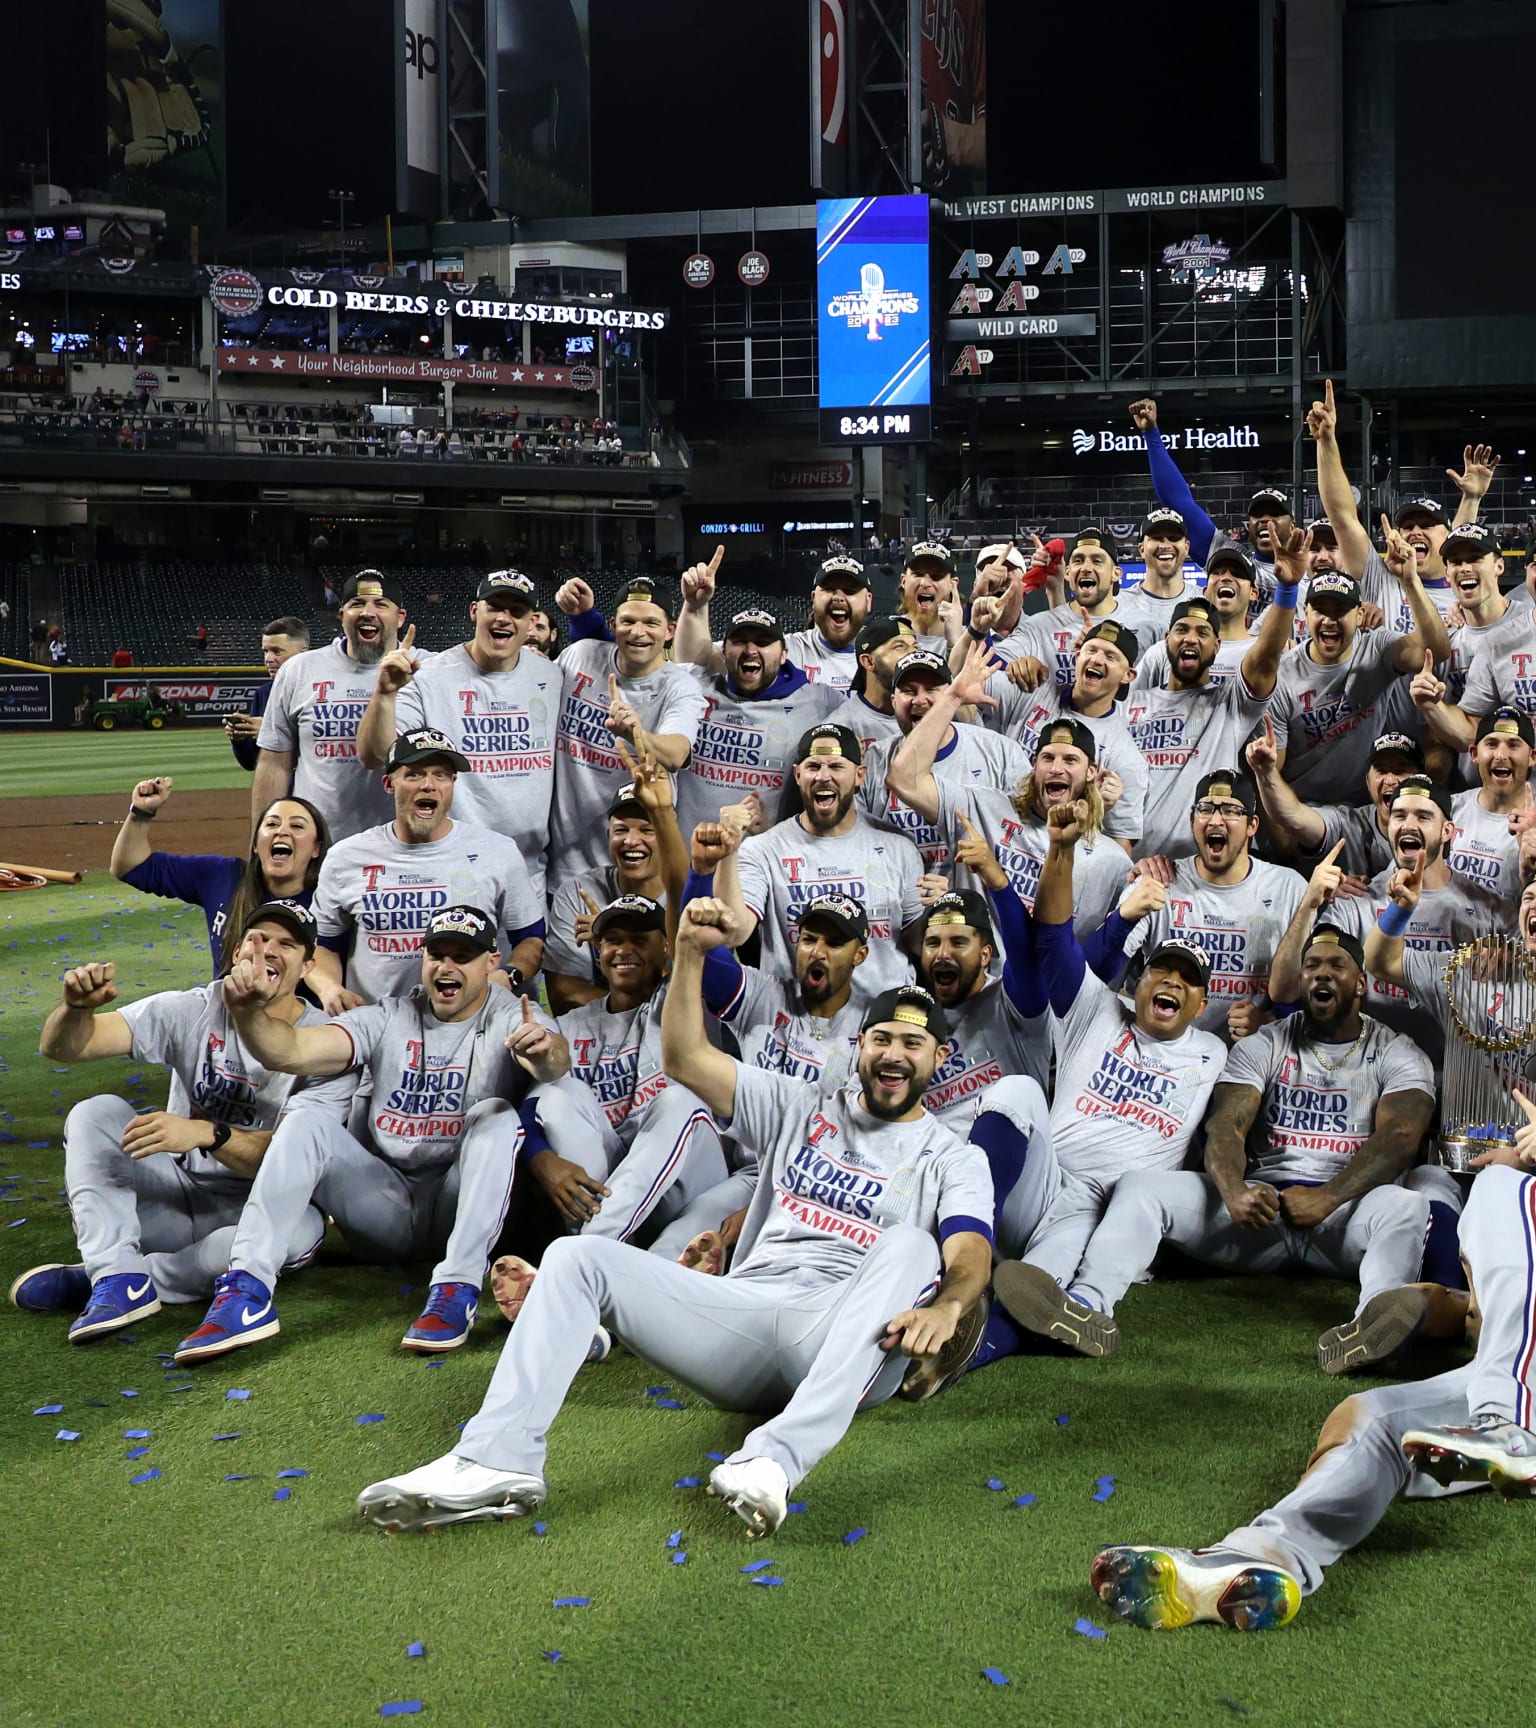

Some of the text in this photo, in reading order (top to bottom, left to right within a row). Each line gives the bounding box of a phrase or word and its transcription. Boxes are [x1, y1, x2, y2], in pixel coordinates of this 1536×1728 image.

[944, 196, 1094, 216] NL WEST CHAMPIONS
[1127, 187, 1265, 207] WORLD CHAMPIONS
[747, 258, 759, 266] JOE
[977, 255, 991, 266] 99
[1025, 253, 1037, 263] 01
[1070, 250, 1083, 261] 02
[1183, 258, 1211, 268] 2001
[742, 265, 765, 274] BLACK
[977, 289, 990, 301] 07
[1024, 287, 1036, 299] 11
[268, 286, 665, 330] COLD BEERS & CHEESEBURGERS
[827, 298, 920, 317] CHAMPIONS
[978, 318, 1058, 336] WILD CARD
[298, 355, 499, 380] Your Neighborhood Burger Joint
[978, 352, 990, 363] 17
[840, 415, 911, 435] 8:34 PM
[1185, 425, 1260, 448] Health
[740, 523, 762, 533] GRILL
[1054, 631, 1071, 651] T
[1511, 653, 1533, 679] T
[312, 681, 334, 703] T
[574, 672, 594, 699] T
[195, 702, 247, 711] SPORTS
[459, 691, 478, 715] T
[1299, 689, 1317, 712] T
[461, 717, 530, 734] WORLD
[1024, 704, 1050, 729] T
[1127, 716, 1185, 739] WORLD
[1128, 706, 1146, 725] T
[461, 734, 531, 753] SERIES
[559, 713, 617, 750] SERIES
[699, 721, 764, 751] WORLD
[693, 740, 761, 767] SERIES
[690, 765, 785, 789] CHAMPIONS
[999, 818, 1023, 847] T
[362, 864, 385, 891] T
[782, 858, 805, 883] T
[361, 890, 448, 911] WORLD
[1170, 899, 1192, 928] T
[1169, 928, 1246, 953] WORLD
[405, 1040, 425, 1070] T
[574, 1038, 596, 1065] T
[1100, 1051, 1177, 1096] WORLD
[1279, 1054, 1298, 1084] T
[401, 1070, 465, 1093] WORLD
[1086, 1070, 1165, 1106] SERIES
[386, 1089, 462, 1114] SERIES
[1273, 1084, 1348, 1114] WORLD
[375, 1114, 465, 1138] CHAMPIO
[1075, 1094, 1181, 1140] CHAMPIONS
[1266, 1107, 1348, 1134] SERIES
[806, 1112, 838, 1147] T
[792, 1145, 883, 1199] WORLD
[779, 1165, 875, 1222] SERIES
[774, 1187, 880, 1251] CHAMPION
